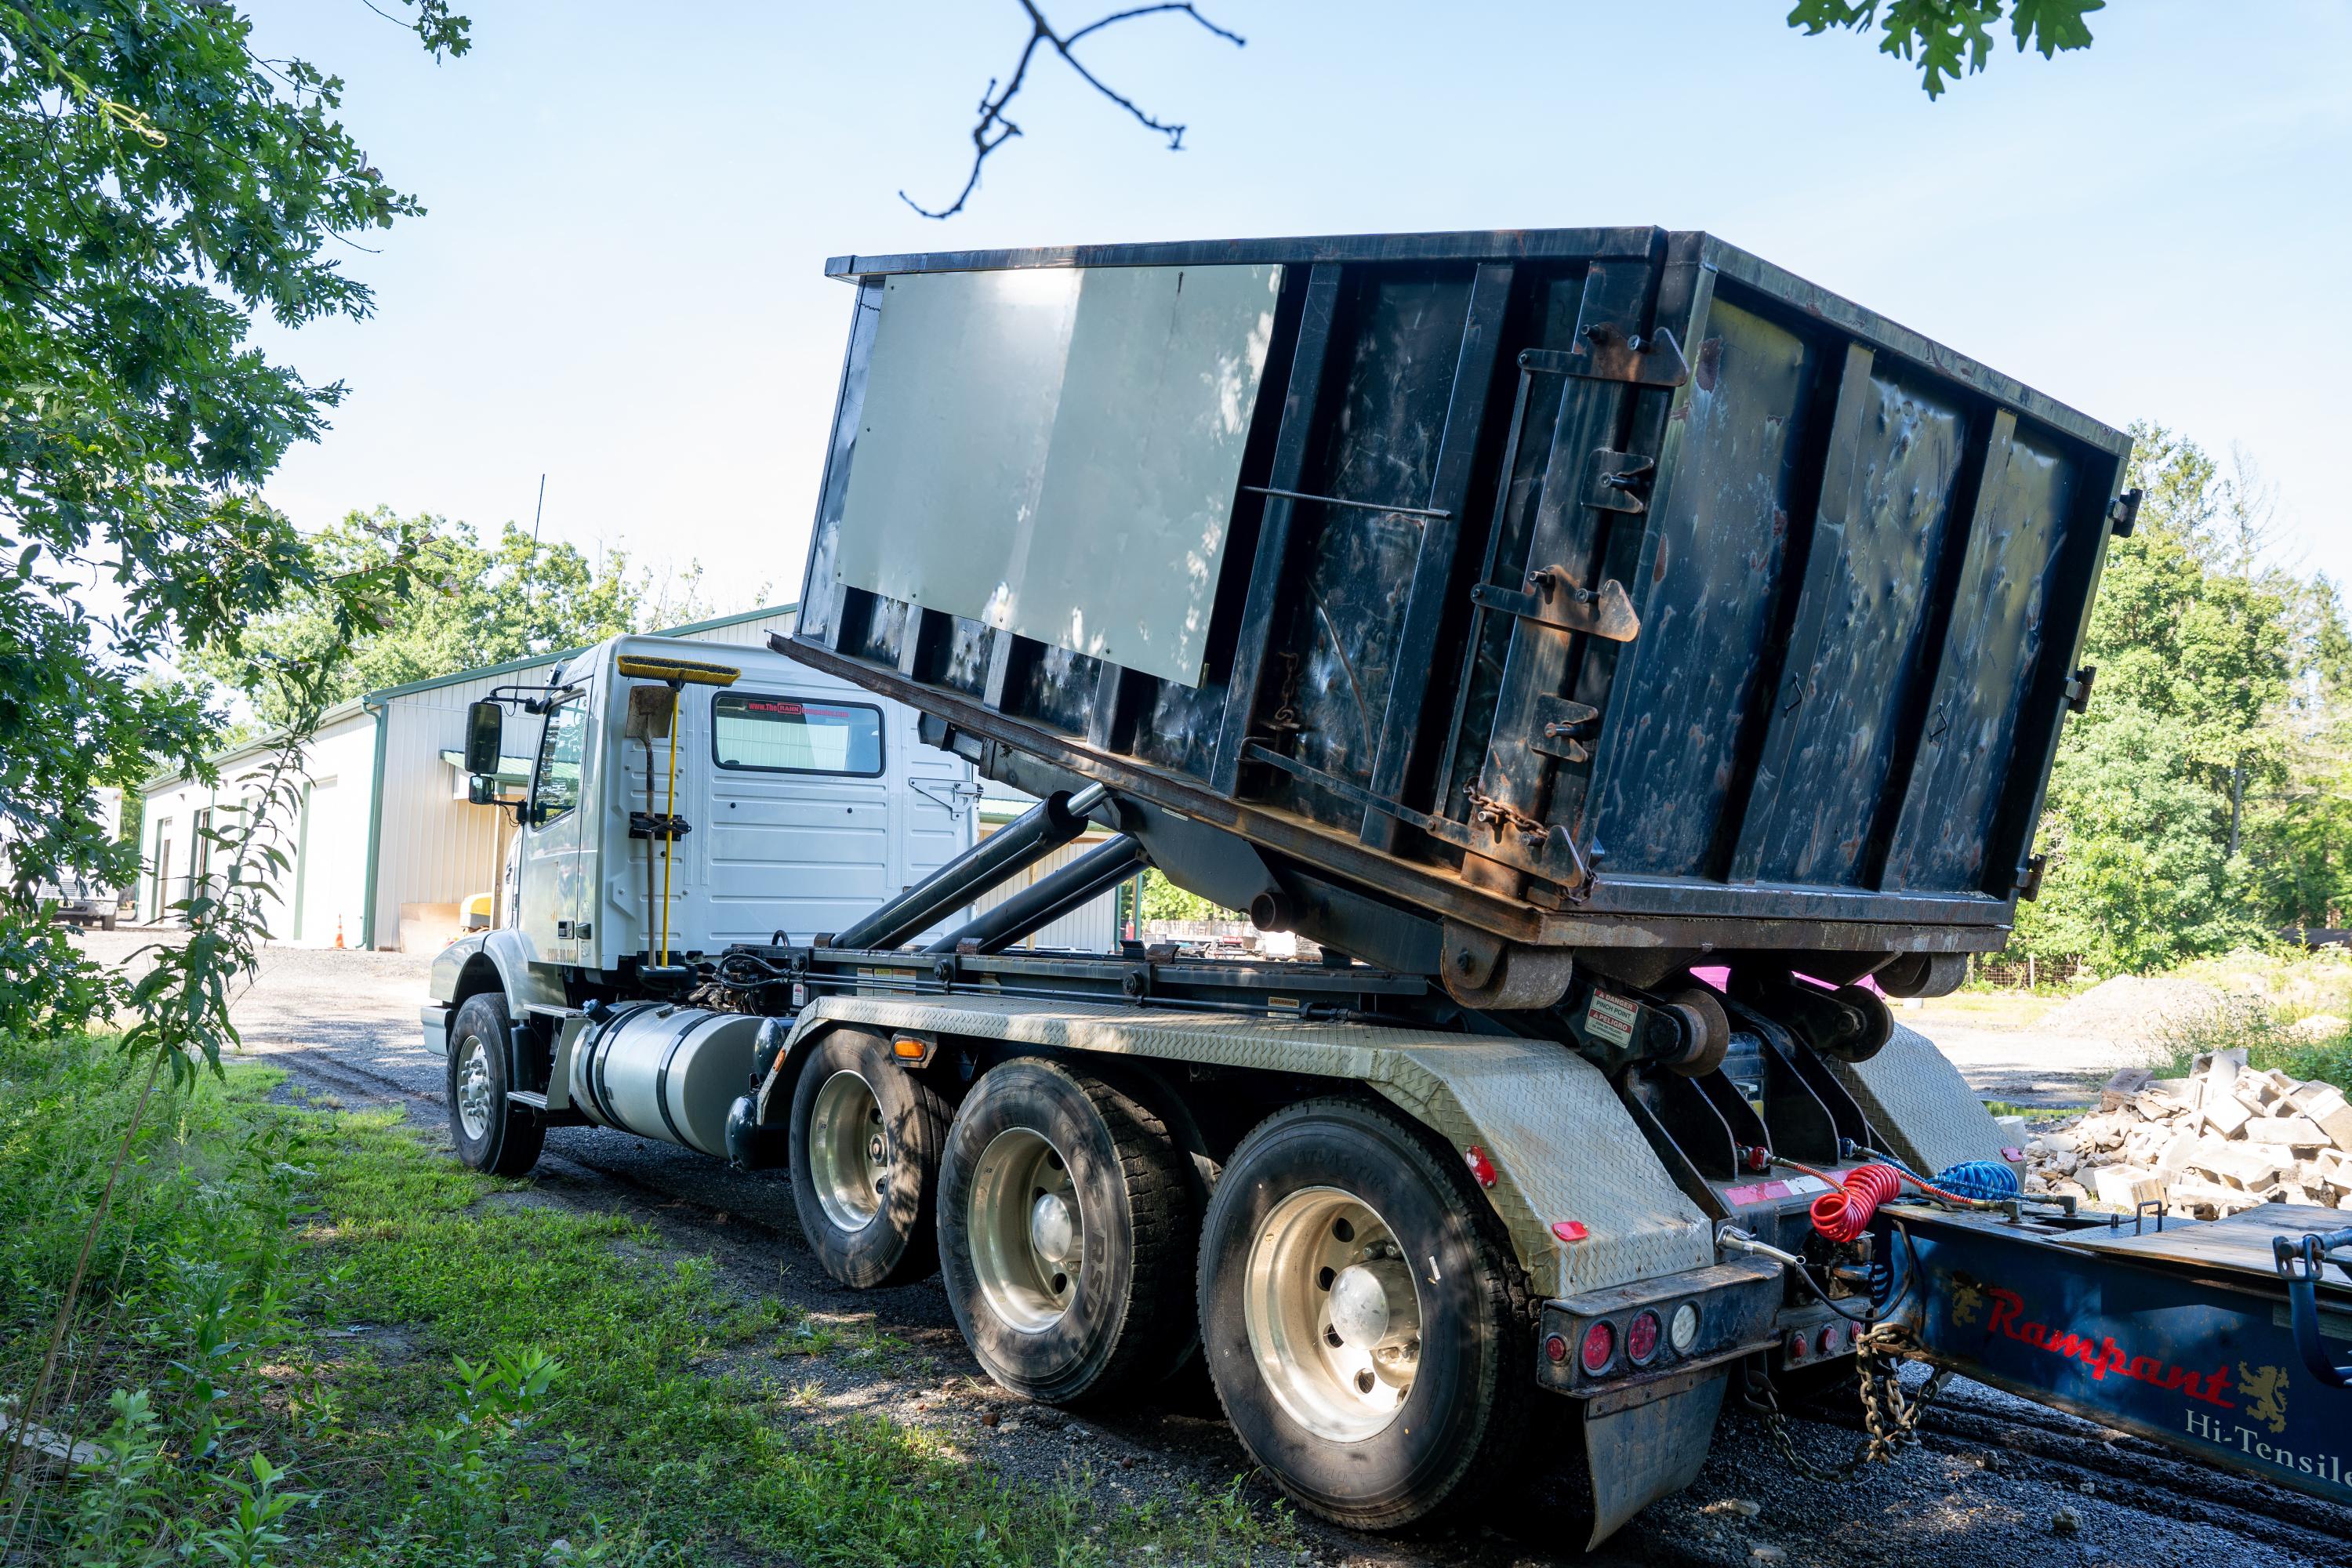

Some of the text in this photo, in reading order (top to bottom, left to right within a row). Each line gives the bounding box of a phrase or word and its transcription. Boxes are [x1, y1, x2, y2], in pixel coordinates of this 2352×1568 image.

[1596, 1000, 1632, 1019] PINCH POINT
[1606, 994, 1633, 1010] DANGER
[1599, 1014, 1628, 1031] PELIGRO
[1987, 1288, 2236, 1408] Rampant
